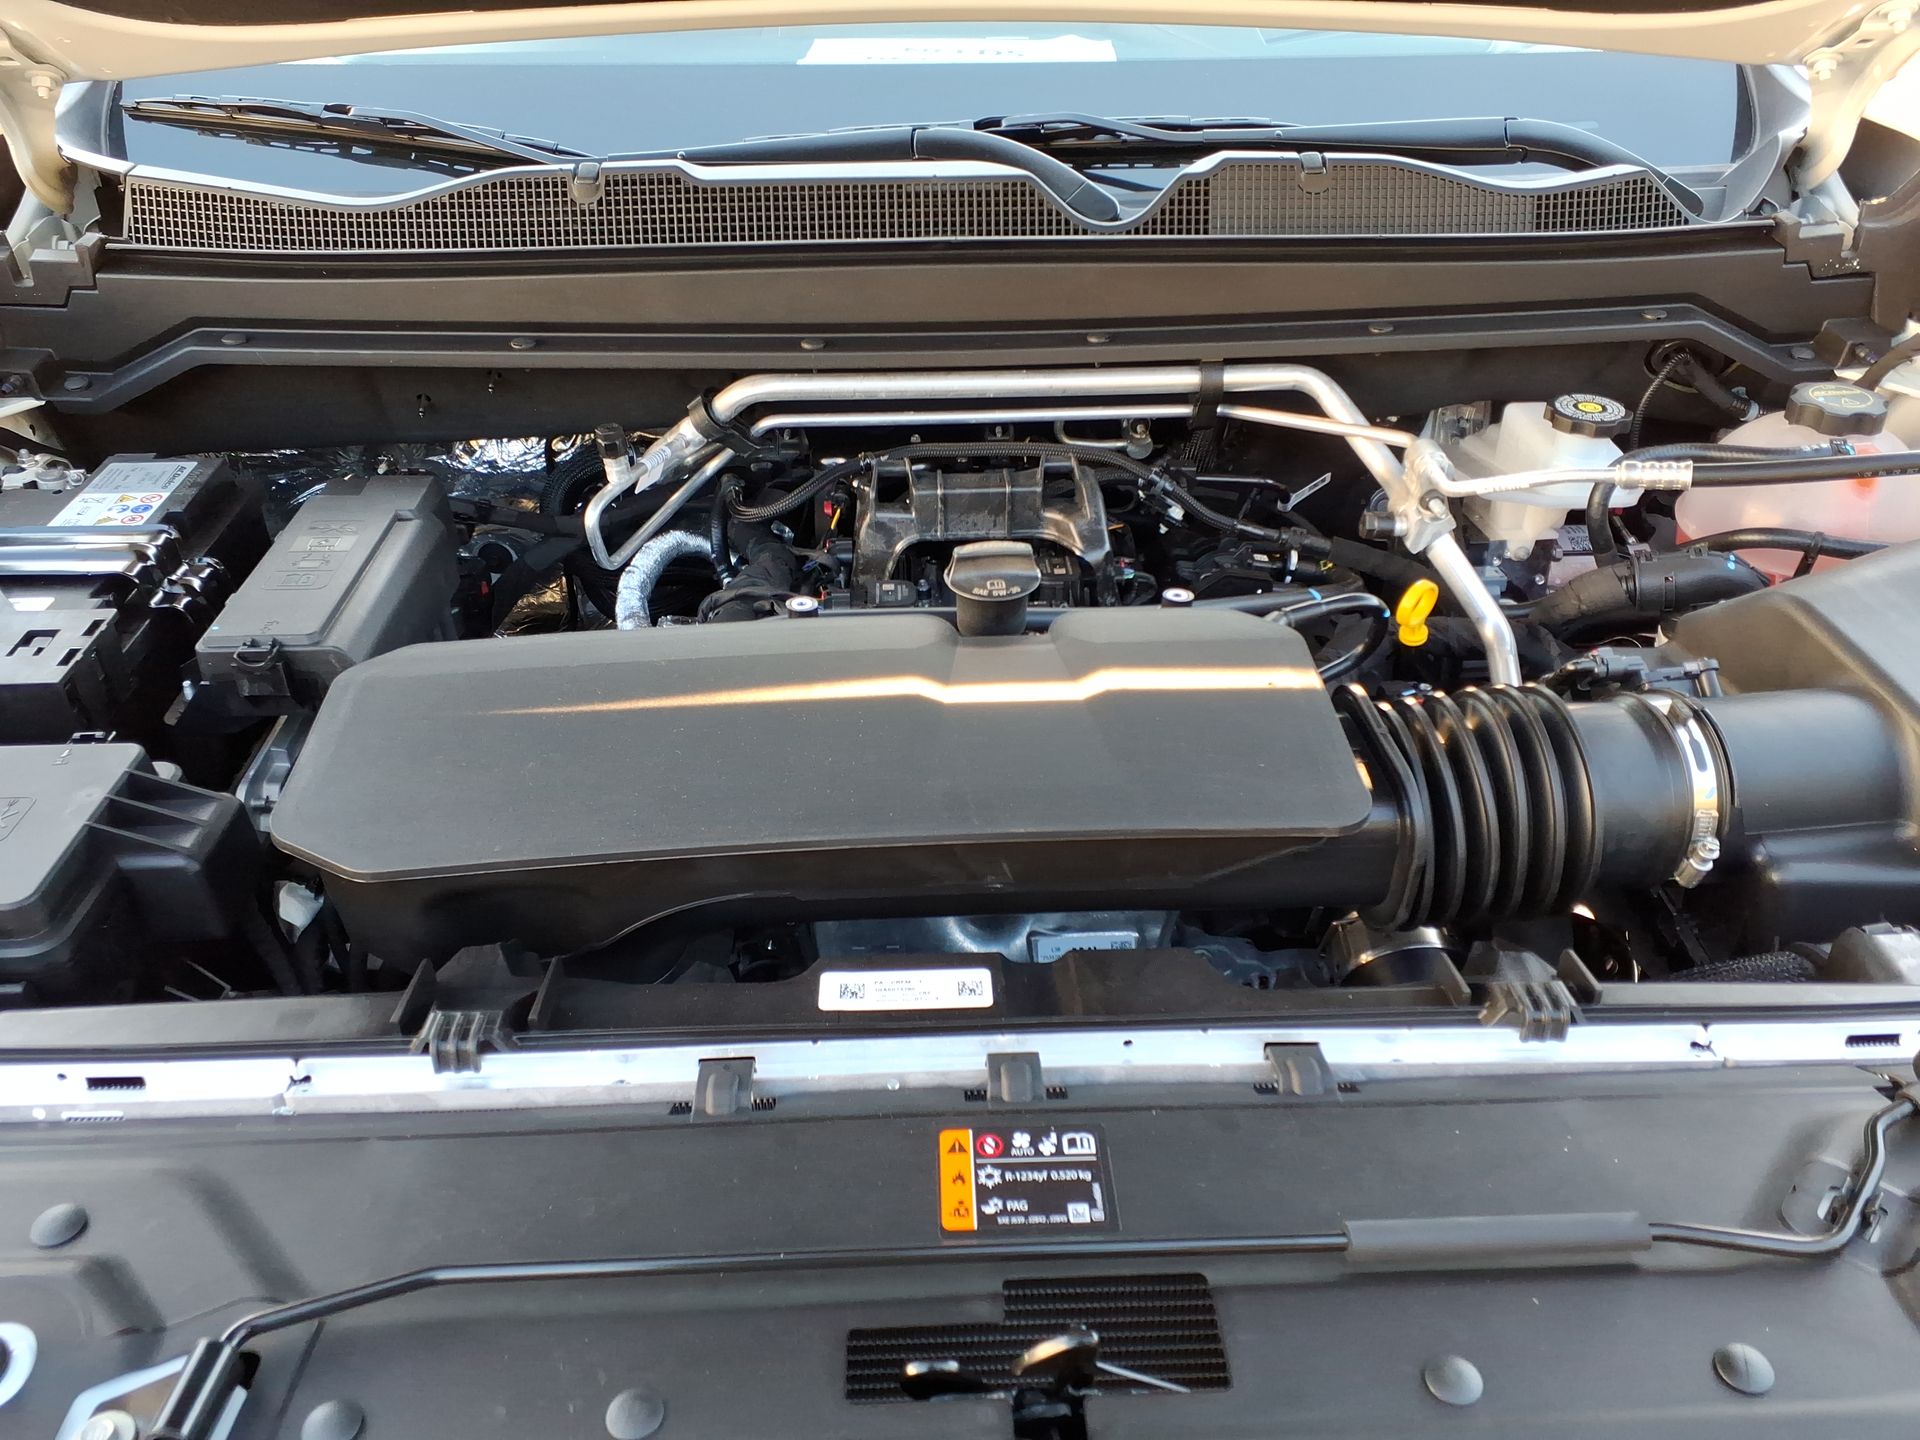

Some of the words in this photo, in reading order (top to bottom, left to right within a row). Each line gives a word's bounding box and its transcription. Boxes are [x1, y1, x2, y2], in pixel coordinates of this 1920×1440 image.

[161, 465, 187, 490] ACDelco
[1010, 1148, 1035, 1157] AUTO
[1005, 1170, 1048, 1183] R-1234yf
[1050, 1169, 1078, 1181] 0.520
[1078, 1169, 1092, 1182] kg
[1006, 1199, 1029, 1212] PAG
